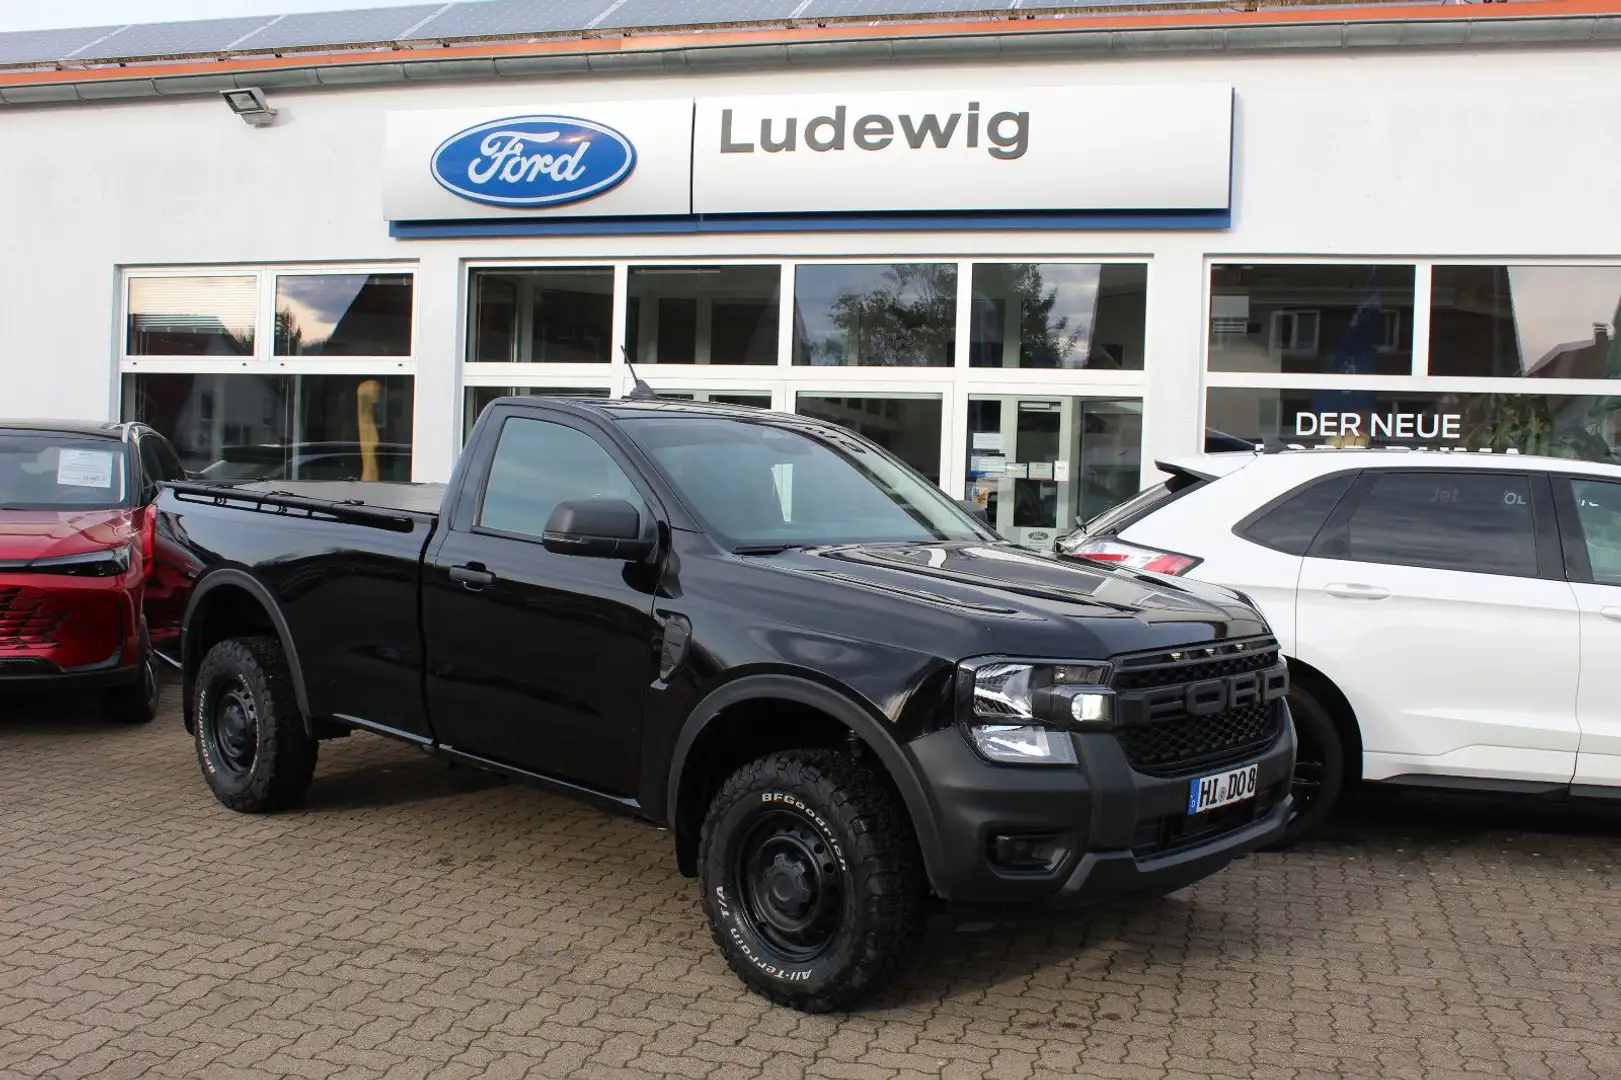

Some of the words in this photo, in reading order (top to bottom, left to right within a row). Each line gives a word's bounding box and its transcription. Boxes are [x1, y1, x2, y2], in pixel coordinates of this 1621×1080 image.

[467, 129, 587, 184] Ford
[721, 101, 1030, 160] Ludewig
[1295, 412, 1361, 436] DER
[1370, 413, 1461, 439] NEUE
[1117, 667, 1290, 722] FORD
[1199, 778, 1218, 807] HI
[762, 793, 846, 871] BFGoodrich
